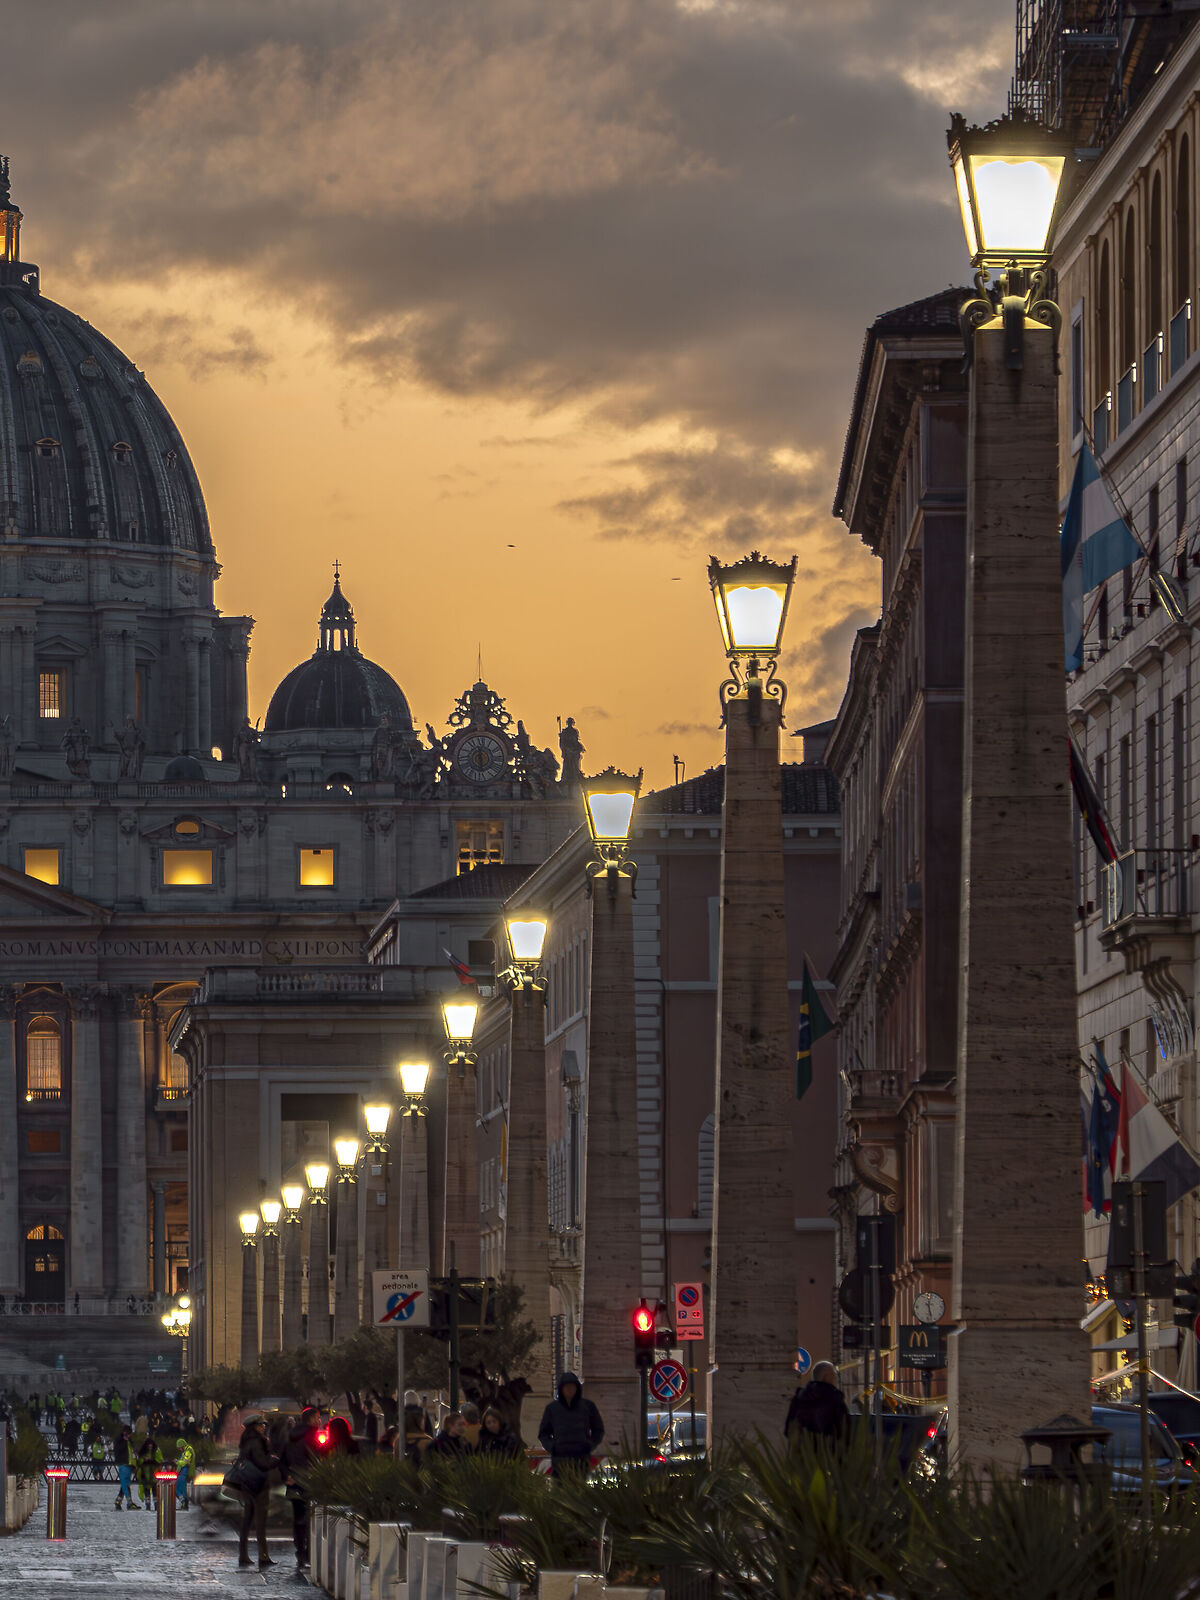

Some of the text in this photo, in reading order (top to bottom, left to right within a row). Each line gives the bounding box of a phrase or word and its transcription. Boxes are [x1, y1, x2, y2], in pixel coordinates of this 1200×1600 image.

[103, 941, 152, 955] PONT
[154, 941, 197, 955] MAX
[200, 941, 226, 955] AN
[231, 941, 308, 956] MDCXII
[382, 1282, 418, 1290] pedonale
